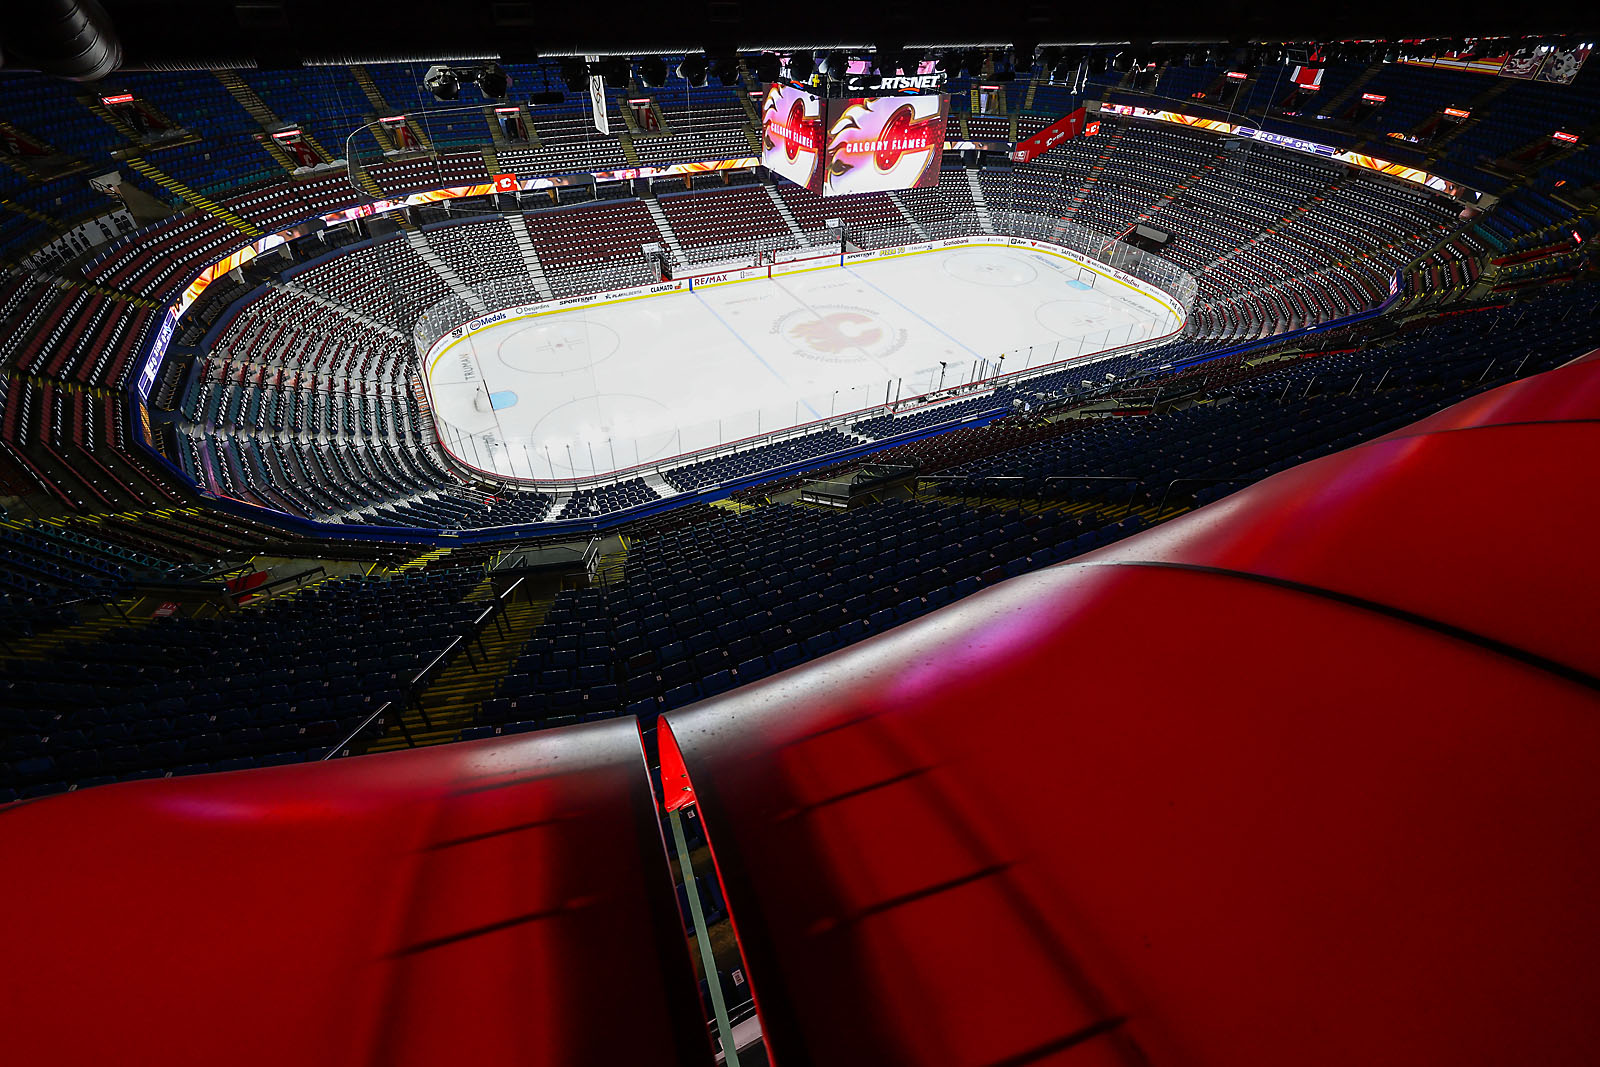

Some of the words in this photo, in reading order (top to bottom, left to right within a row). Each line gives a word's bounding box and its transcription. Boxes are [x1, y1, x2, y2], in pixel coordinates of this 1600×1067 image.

[848, 75, 940, 91] RTSNET
[771, 122, 792, 138] CALGARY
[793, 129, 813, 149] FLAMES
[846, 140, 889, 153] CALGARY
[892, 138, 926, 151] FLAMES
[943, 238, 969, 247] Scotiabank
[847, 251, 876, 260] SPORTSNET
[1060, 249, 1078, 259] SAFEWAY
[694, 274, 728, 286] RE/MAX
[650, 284, 673, 293] CLAMATO
[559, 295, 598, 306] SPORTSNET
[523, 304, 550, 313] Desjardins
[480, 312, 507, 326] Medals
[451, 327, 463, 337] SN
